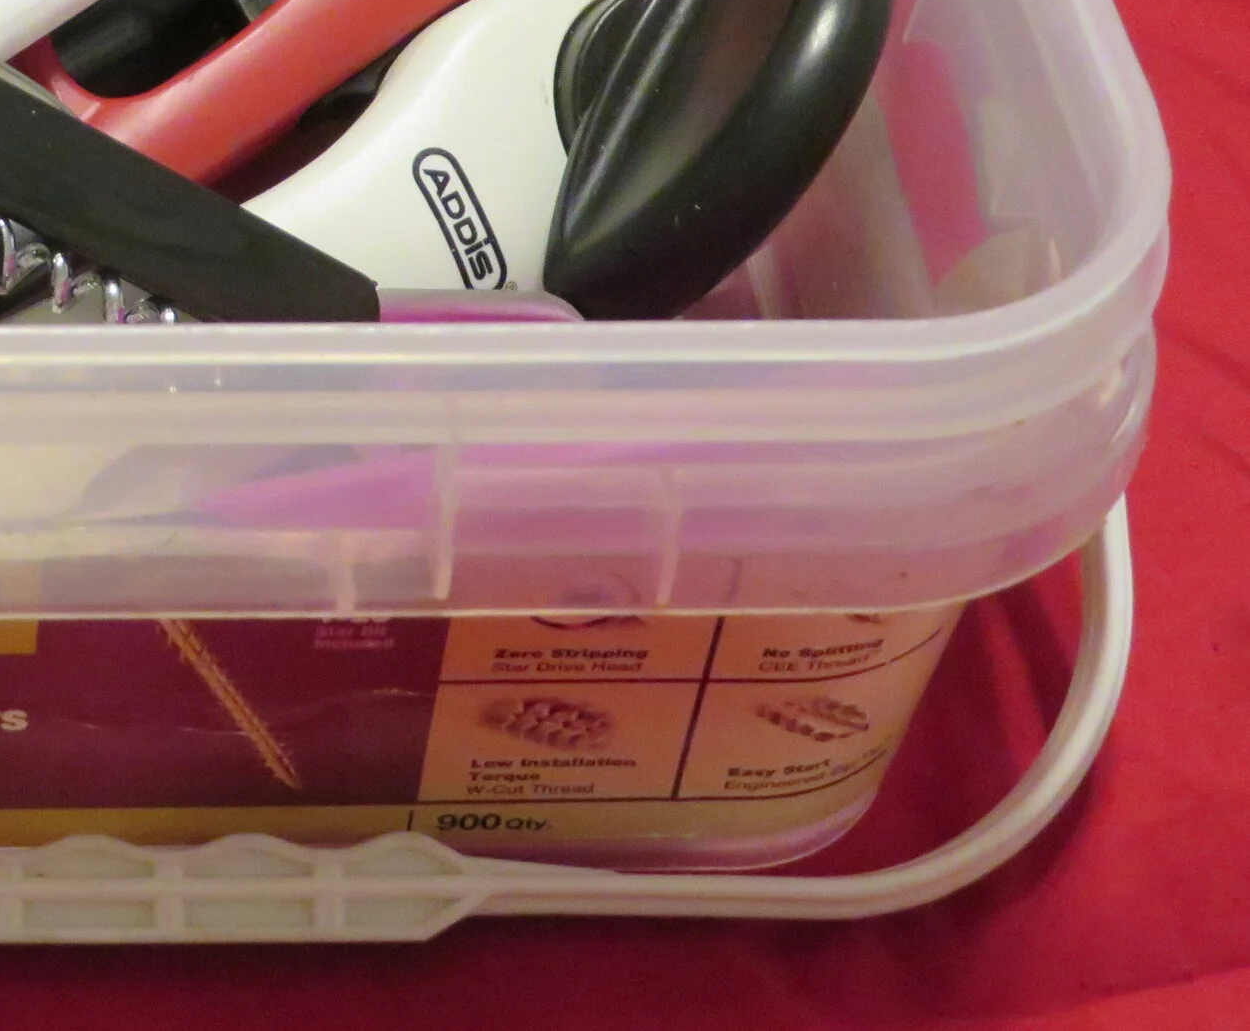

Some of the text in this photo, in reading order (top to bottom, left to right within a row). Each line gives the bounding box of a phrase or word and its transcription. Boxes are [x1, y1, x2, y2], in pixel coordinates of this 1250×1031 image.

[494, 646, 649, 661] Zero Stripping
[469, 756, 637, 769] Low Installation
[468, 771, 542, 782] Torque
[436, 813, 502, 831] 900
